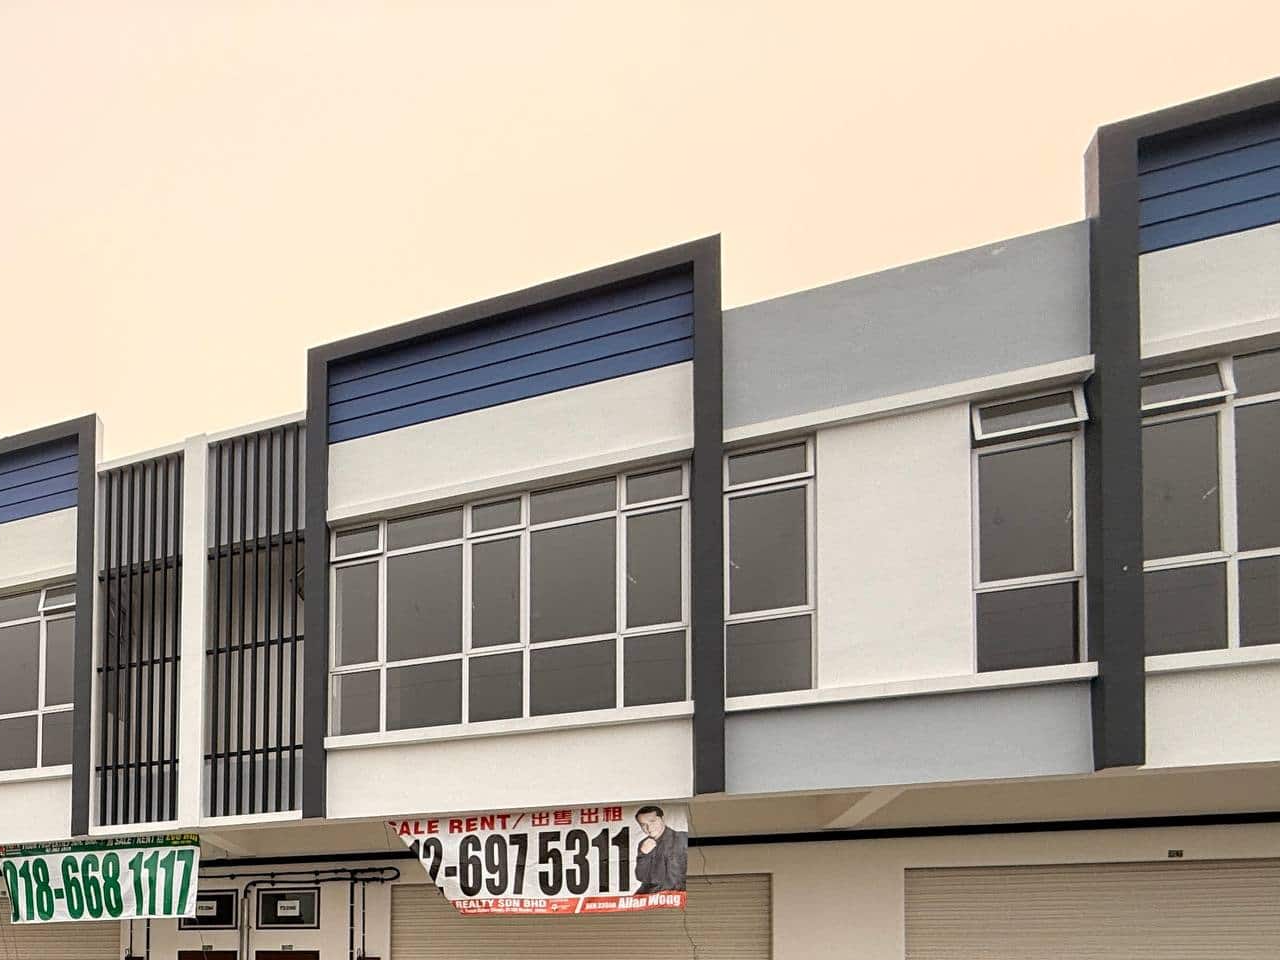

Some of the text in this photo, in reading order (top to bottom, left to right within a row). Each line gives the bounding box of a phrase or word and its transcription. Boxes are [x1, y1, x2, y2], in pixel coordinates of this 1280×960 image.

[538, 826, 630, 896] 5311
[3, 849, 195, 922] 018-668 1117
[455, 899, 495, 909] REALTY
[498, 899, 520, 908] SDN
[523, 899, 547, 908] BHD
[618, 897, 647, 909] Allan
[648, 893, 681, 907] Wong
